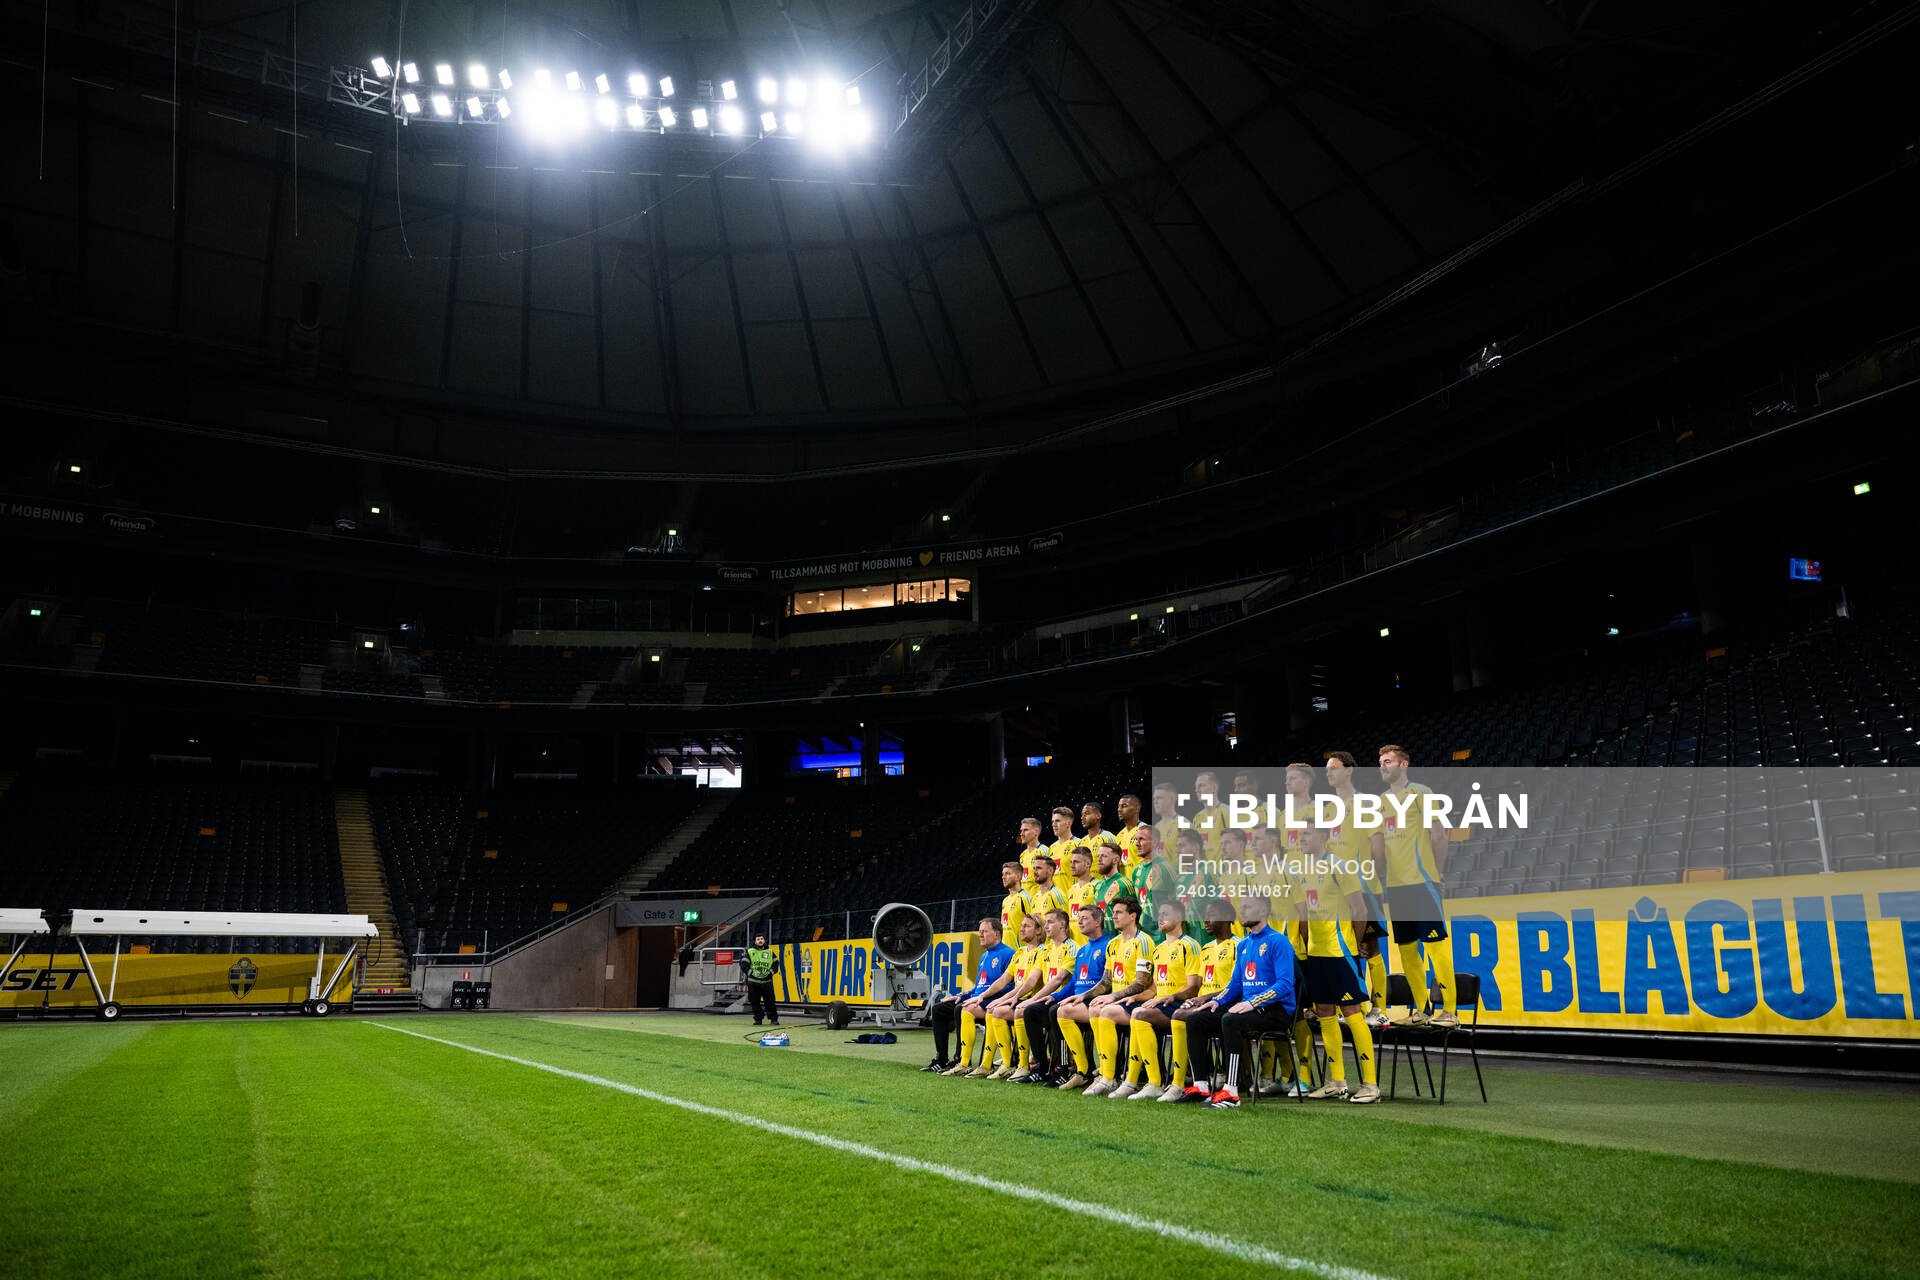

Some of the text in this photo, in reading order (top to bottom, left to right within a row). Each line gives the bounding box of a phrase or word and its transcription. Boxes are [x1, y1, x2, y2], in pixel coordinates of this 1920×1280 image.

[11, 504, 84, 523] MOBBNING
[109, 518, 146, 530] friends
[771, 544, 1021, 579] TILLSAMMANS MOT MOBBNING FRIENDS ARENA
[723, 570, 752, 579] friends
[644, 910, 675, 919] Gate 2
[820, 948, 839, 996] VI
[839, 944, 867, 997] ÄR
